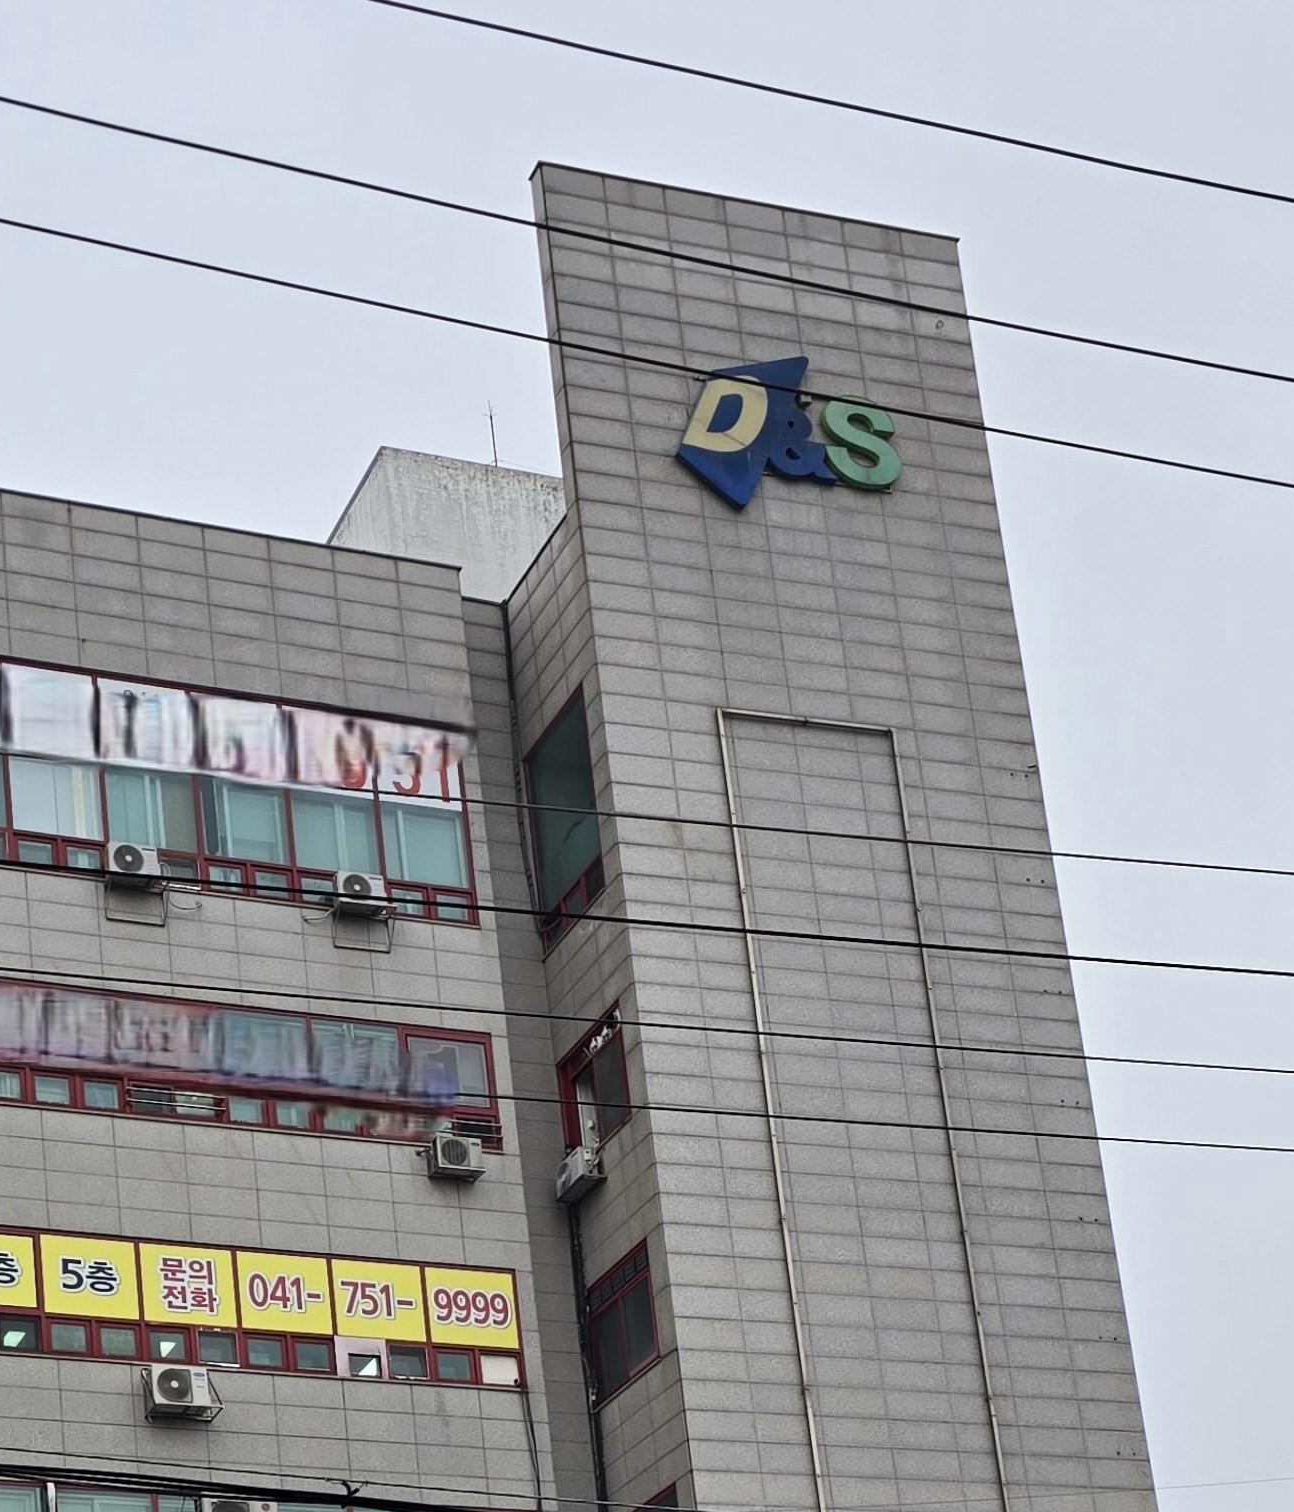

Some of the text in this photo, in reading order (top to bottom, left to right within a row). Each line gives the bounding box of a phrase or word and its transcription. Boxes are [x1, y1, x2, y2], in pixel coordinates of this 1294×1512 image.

[682, 374, 903, 490] D&S
[58, 1254, 121, 1297] 5층
[158, 1254, 217, 1287] 문의
[160, 1283, 220, 1317] 전화
